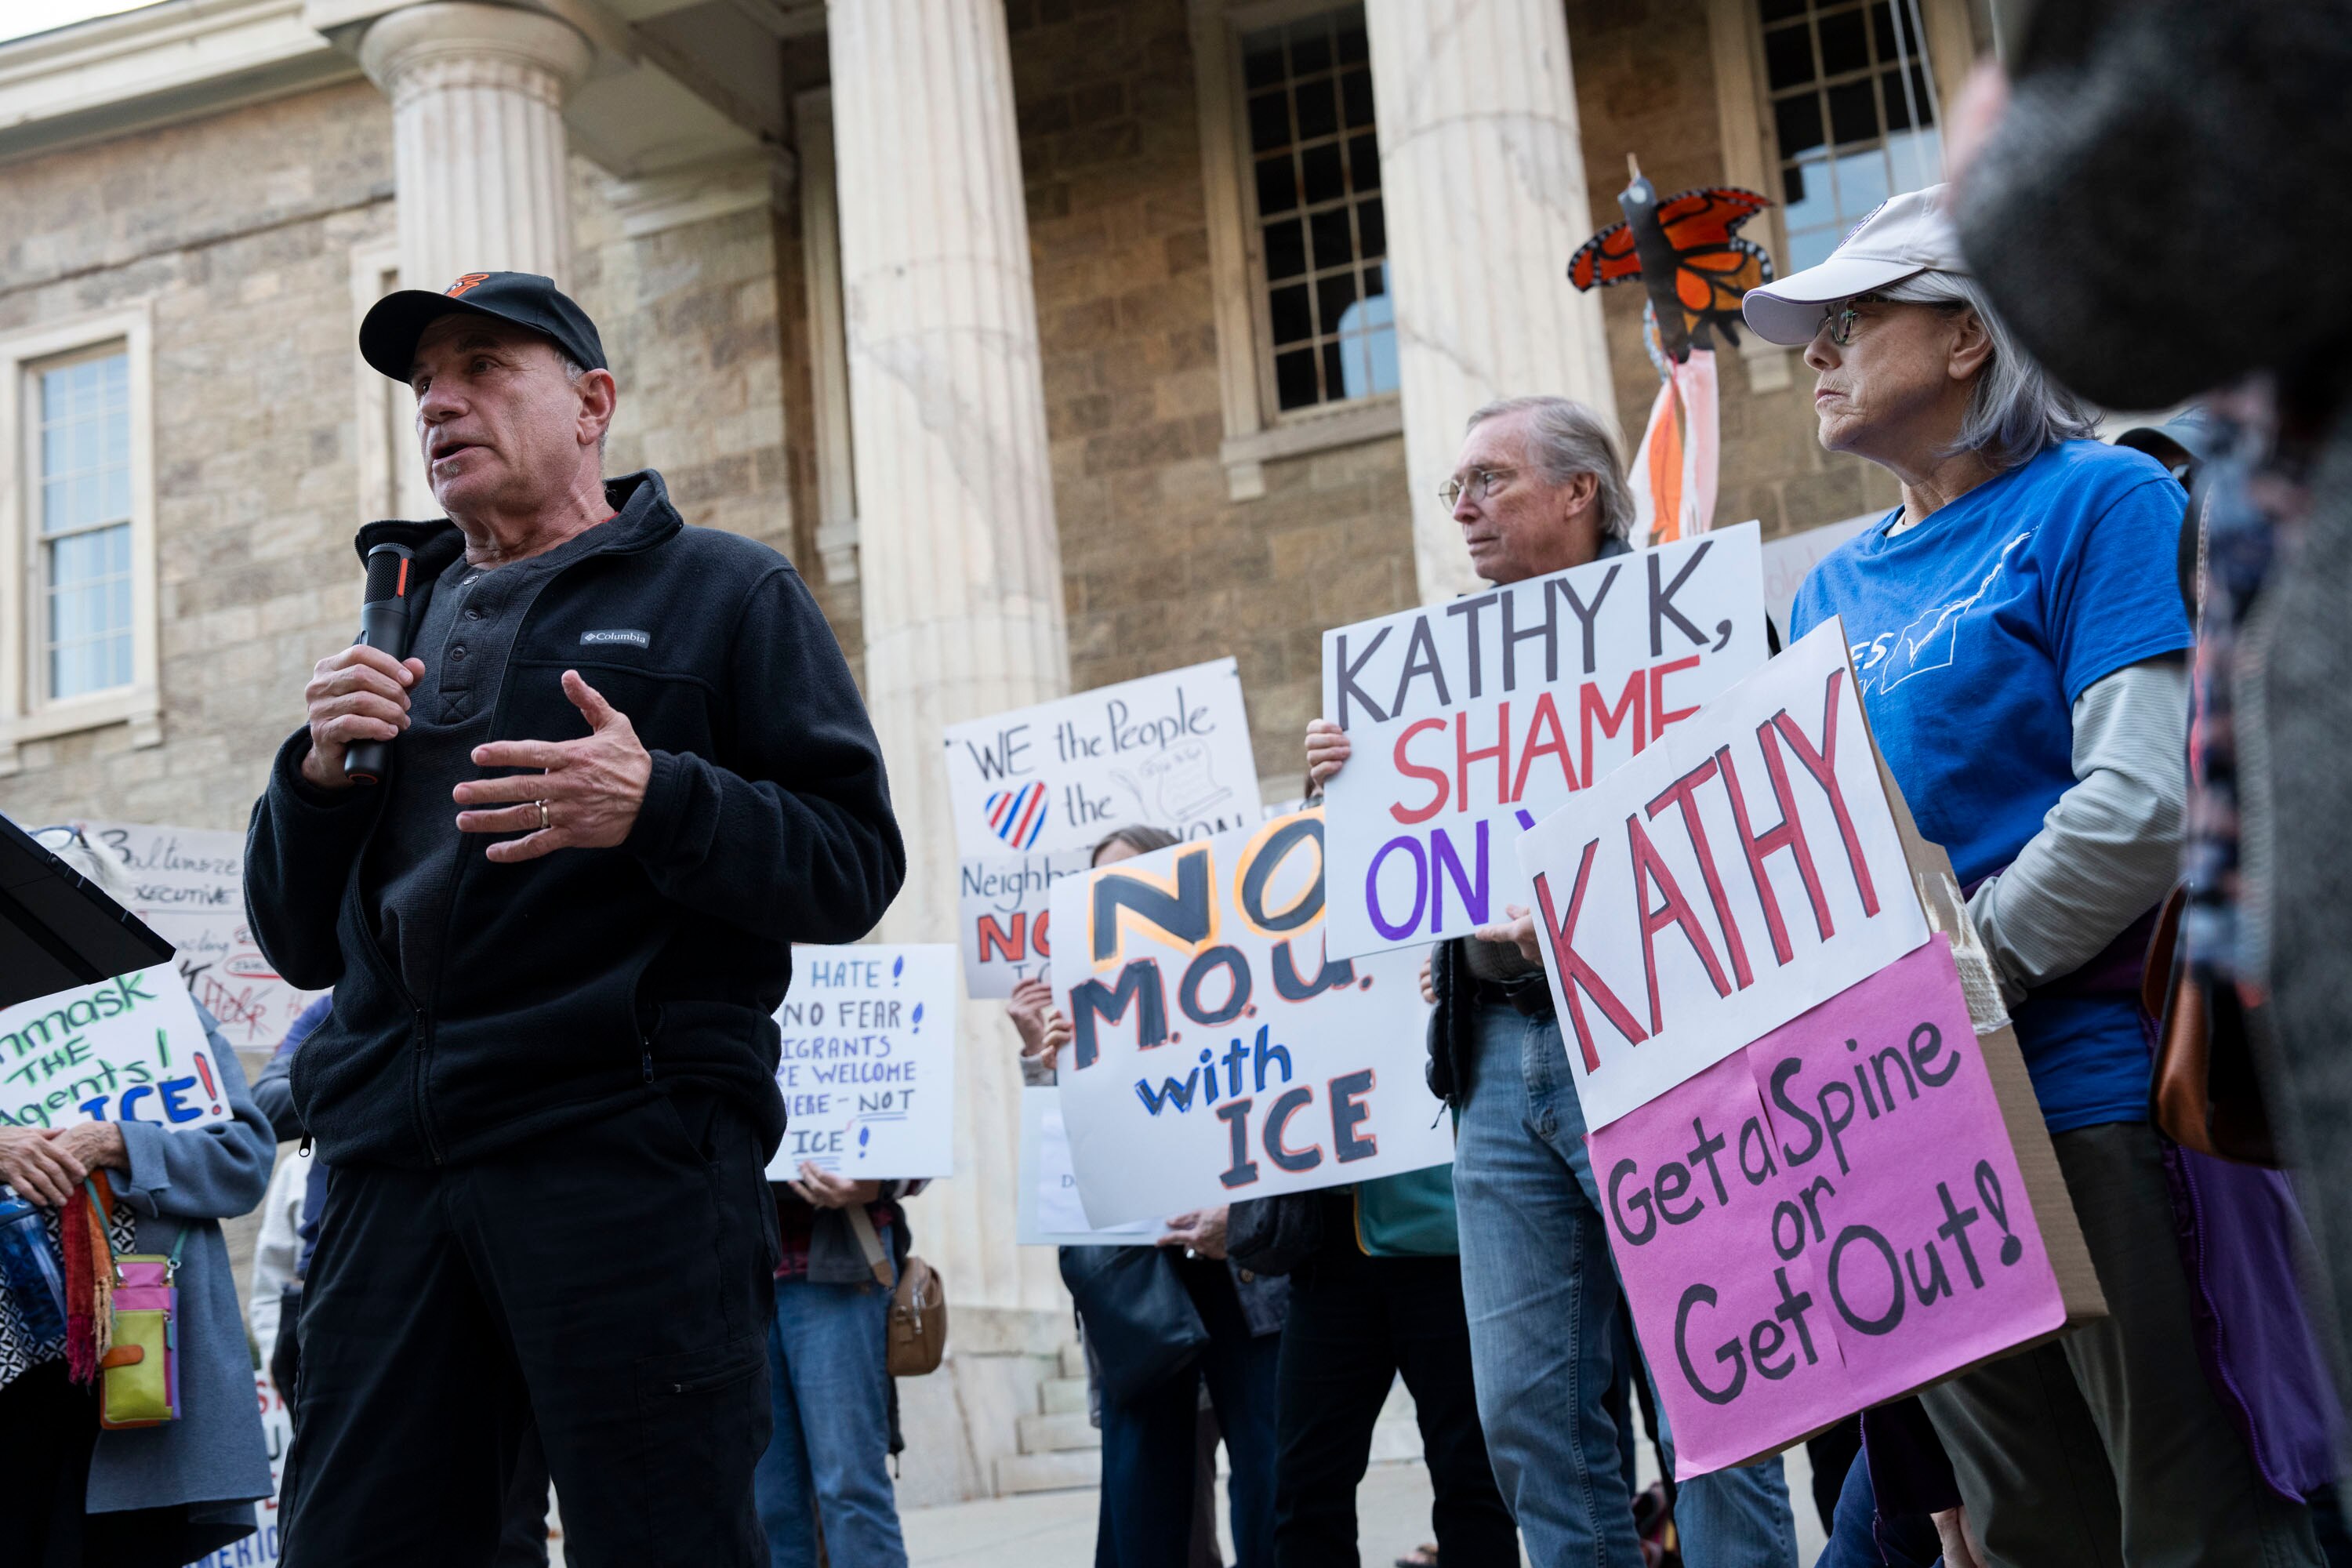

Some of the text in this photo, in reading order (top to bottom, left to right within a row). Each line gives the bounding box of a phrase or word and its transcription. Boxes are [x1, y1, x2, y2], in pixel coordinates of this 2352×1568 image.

[596, 632, 646, 643] Columbia
[1336, 539, 1733, 732] KATHY K,
[965, 724, 1036, 782] WE
[1053, 720, 1106, 763] the
[1106, 686, 1217, 753] People
[1063, 782, 1117, 828] the
[1087, 808, 1325, 973] NO
[1365, 818, 1490, 942] ON
[1532, 666, 1881, 1076] KATHY
[4, 1035, 94, 1085] THE
[783, 1000, 925, 1035] NO FEAR!
[811, 1061, 916, 1084] WELCOME
[858, 1088, 915, 1112] NOT
[1134, 1023, 1293, 1116] with
[1215, 1067, 1378, 1189] ICE
[1607, 1021, 1961, 1247] Get a Spine
[1770, 1174, 1836, 1261] or
[1674, 1158, 2024, 1406] Get Out!
